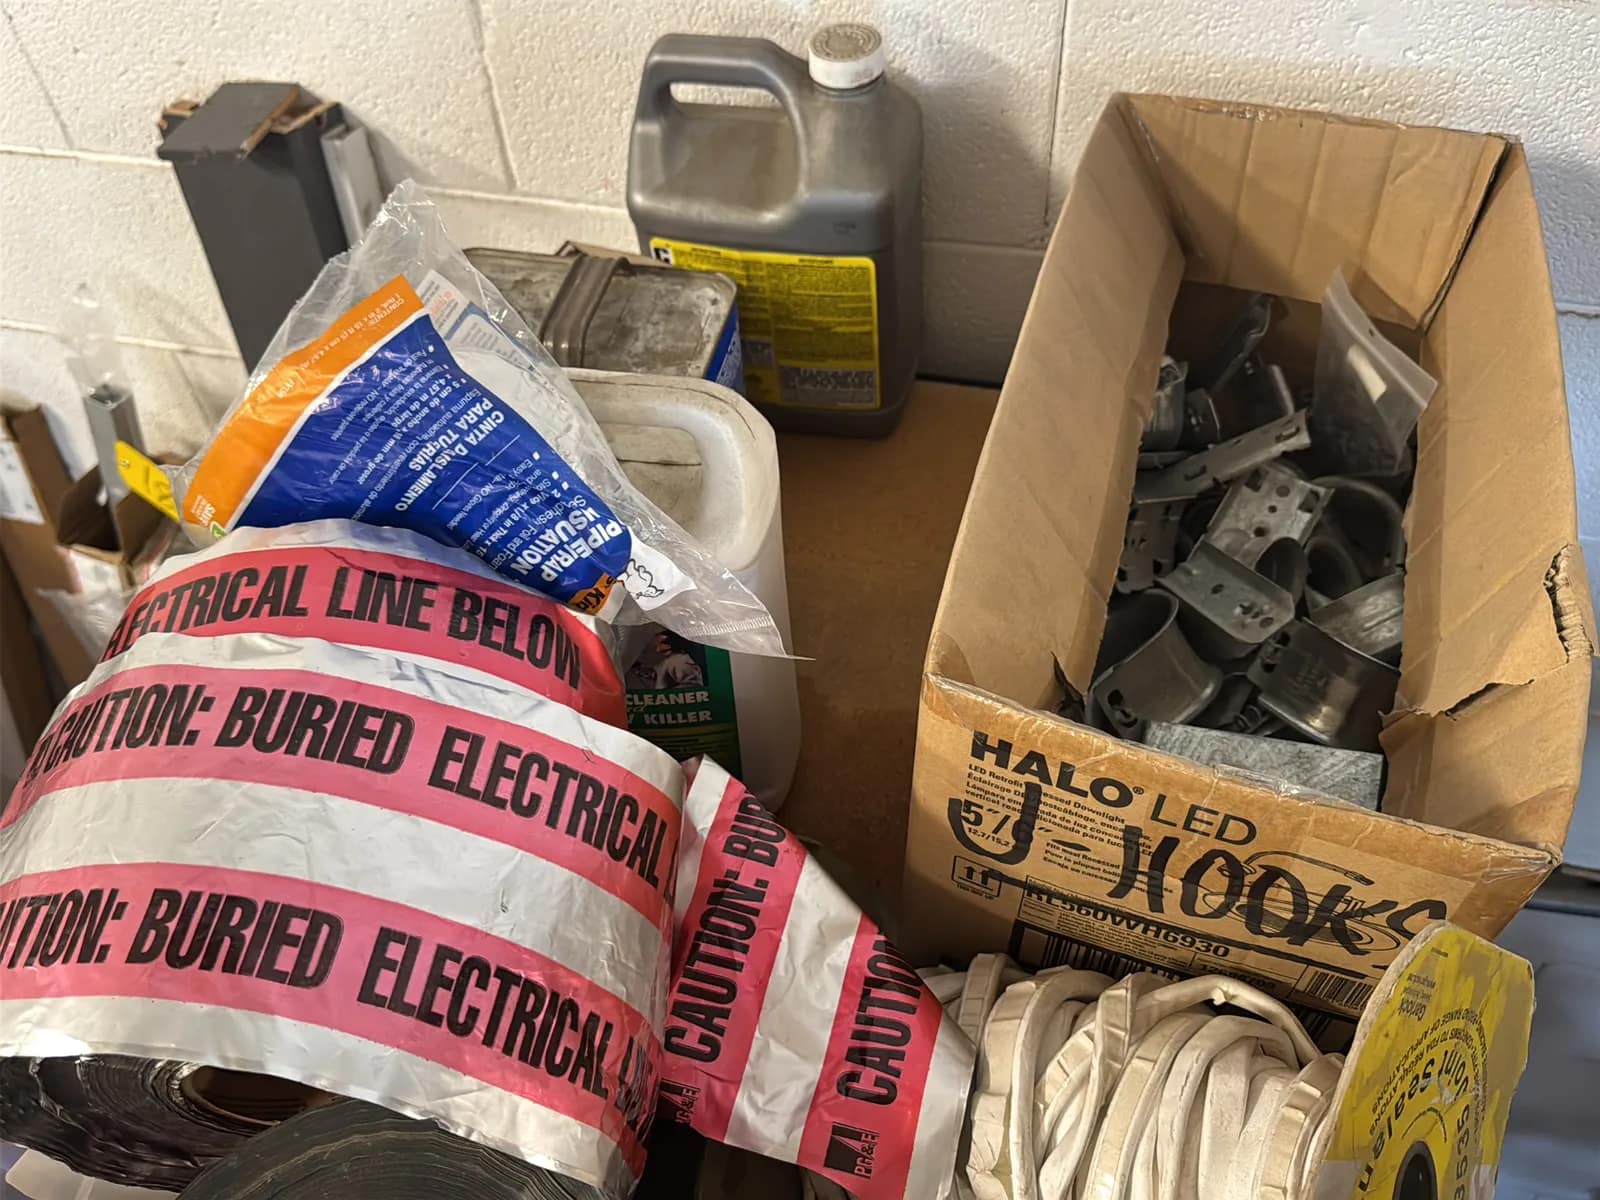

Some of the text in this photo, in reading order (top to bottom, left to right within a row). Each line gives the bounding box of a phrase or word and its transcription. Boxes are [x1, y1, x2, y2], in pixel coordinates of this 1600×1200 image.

[450, 386, 480, 415] Espuma
[453, 395, 493, 433] PARA
[452, 441, 468, 459] D
[463, 408, 506, 448] CINTA
[569, 517, 622, 559] PIPE
[327, 567, 440, 631] LINE
[447, 587, 582, 690] BELOW
[644, 710, 712, 724] KILLER
[216, 686, 415, 775] BURIED
[427, 724, 668, 889] ELECTRICAL
[965, 781, 1005, 801] Lámpara
[1058, 815, 1071, 824] de
[1073, 820, 1089, 829] luz
[968, 763, 986, 775] LED
[987, 771, 1024, 788] Retrofit
[1073, 801, 1125, 824] Downlight
[964, 789, 1000, 806] vertical
[1082, 831, 1104, 842] para
[1151, 795, 1257, 846] LED
[664, 793, 787, 1063] CAUTION: BUR
[126, 888, 344, 991] BURIED
[358, 925, 613, 1102] ELECTRICAL
[1369, 1050, 1426, 1136] REGULATIONS
[1371, 1031, 1430, 1114] APPLICATIONS
[1438, 1048, 1469, 1099] Joint
[1356, 1057, 1437, 1194] Sealan
[854, 1131, 880, 1179] PG&E
